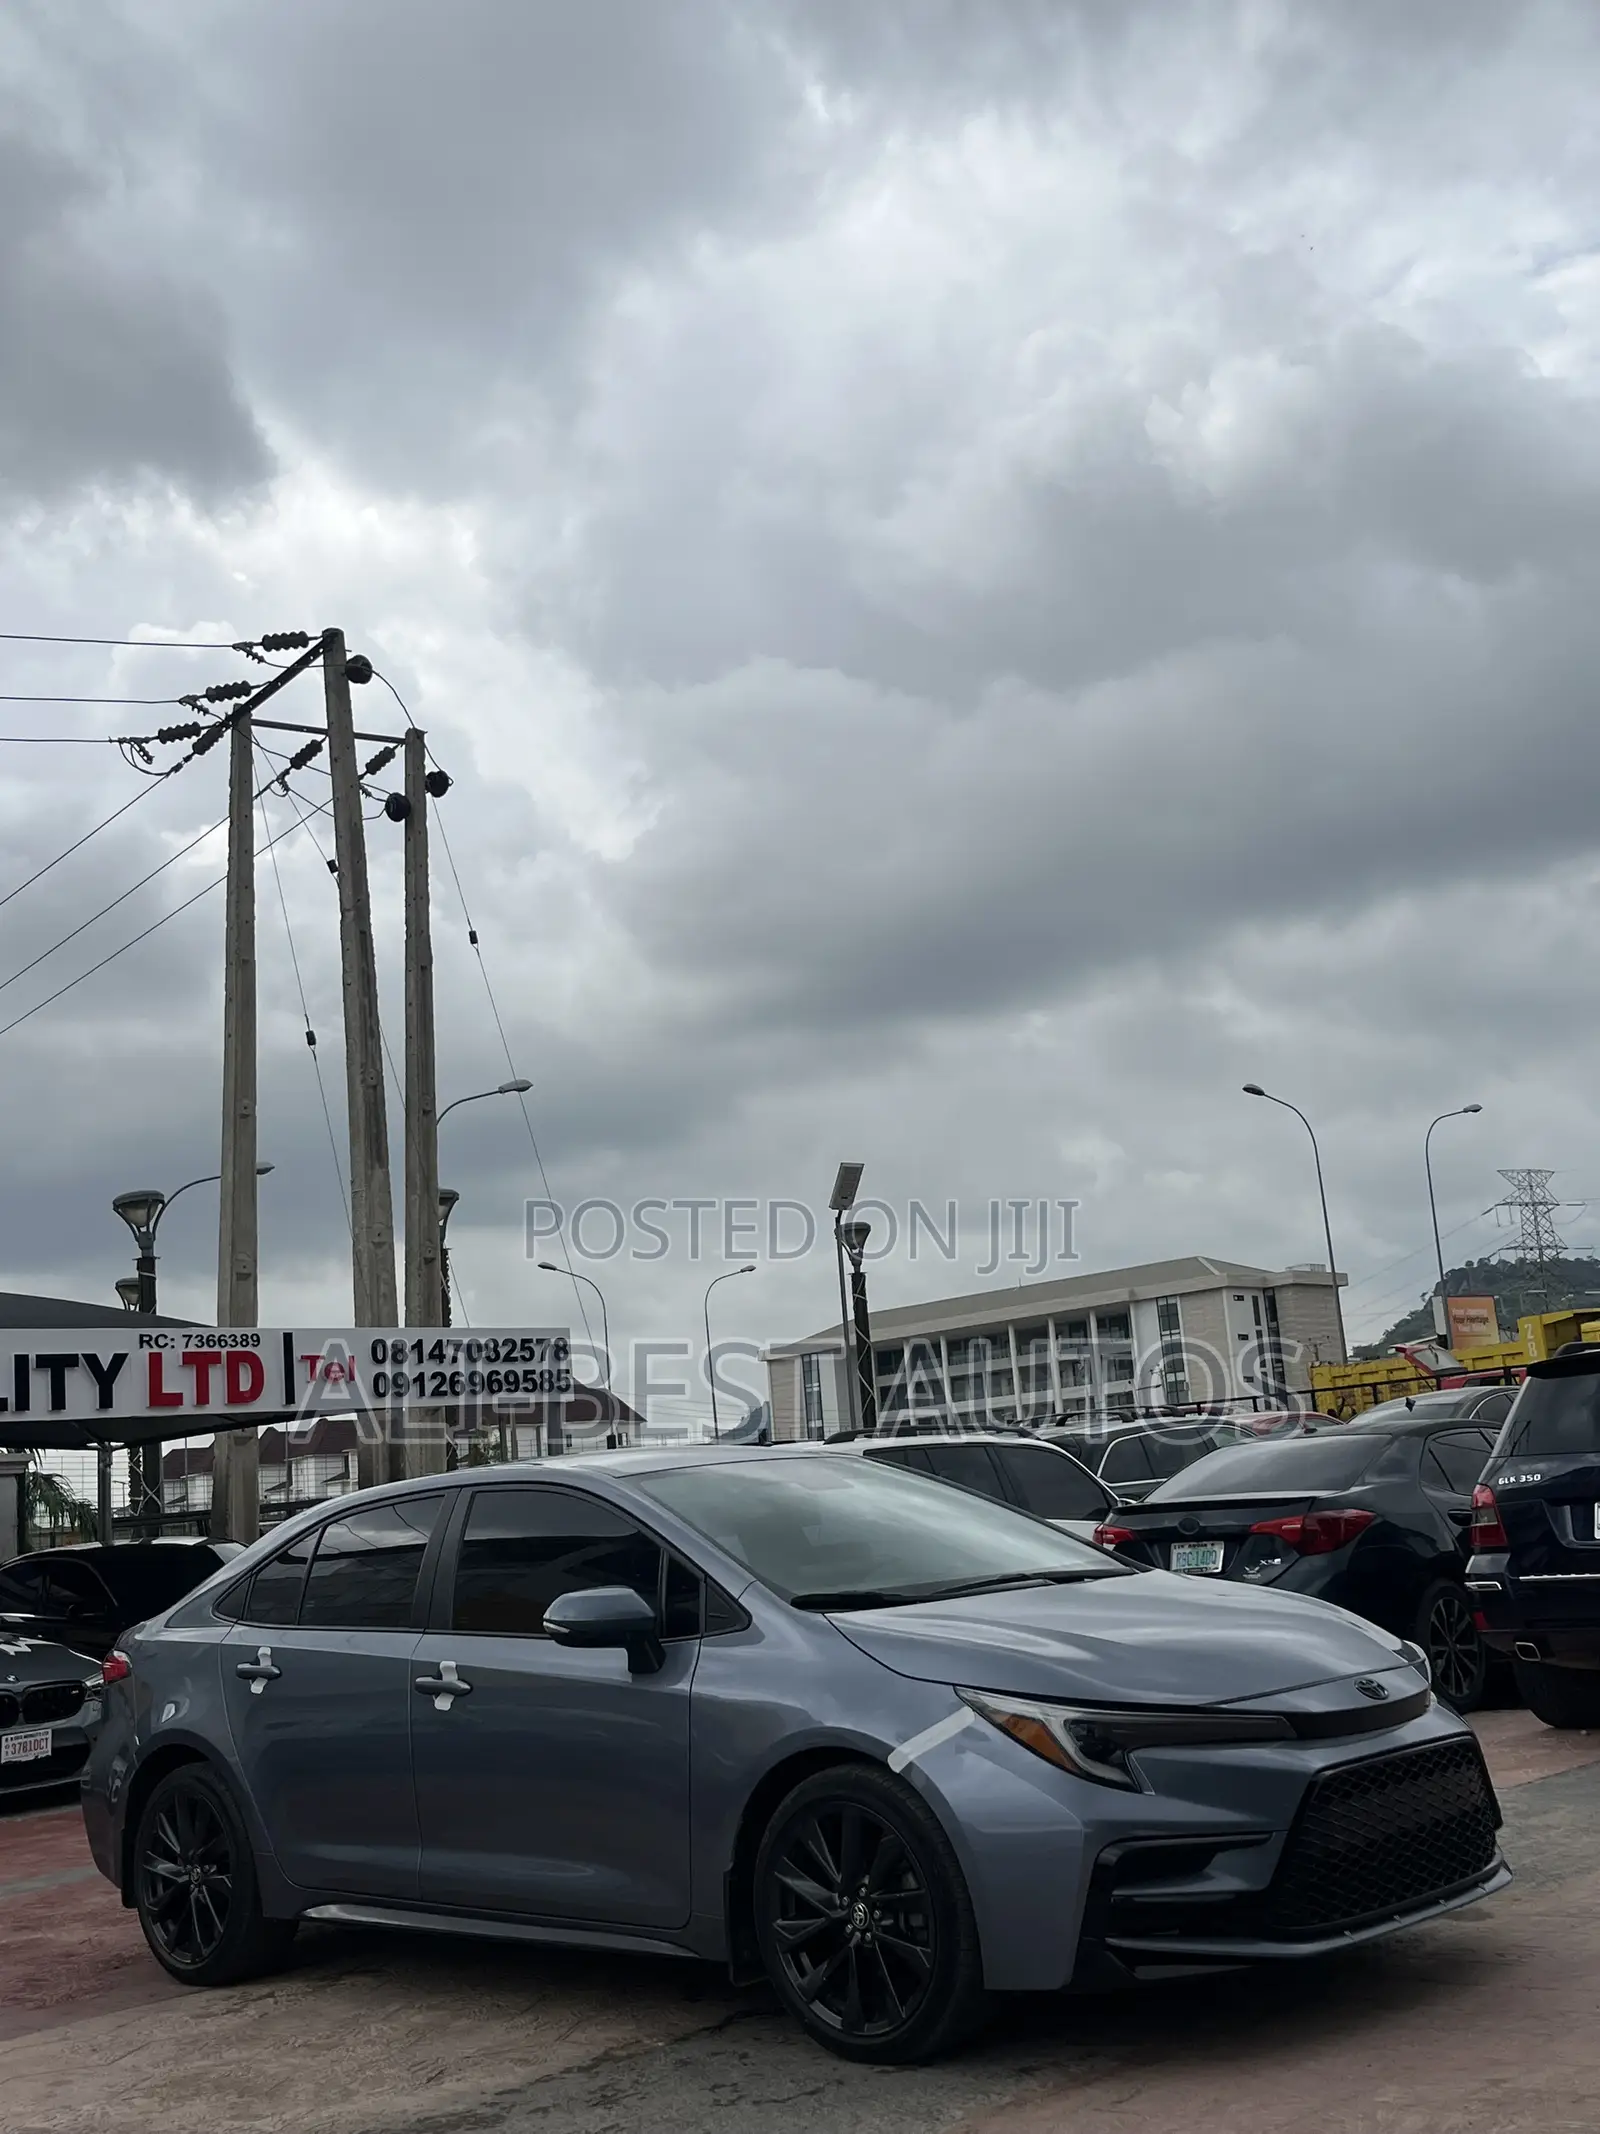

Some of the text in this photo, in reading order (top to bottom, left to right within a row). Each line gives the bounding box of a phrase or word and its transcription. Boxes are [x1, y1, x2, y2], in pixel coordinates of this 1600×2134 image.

[139, 1333, 261, 1349] RC: 7366389
[371, 1337, 569, 1365] 08147082578
[0, 1350, 265, 1411] ITY LTD
[300, 1355, 356, 1384] Tel
[372, 1368, 571, 1398] 09126969585
[1498, 1473, 1541, 1485] GLK 350
